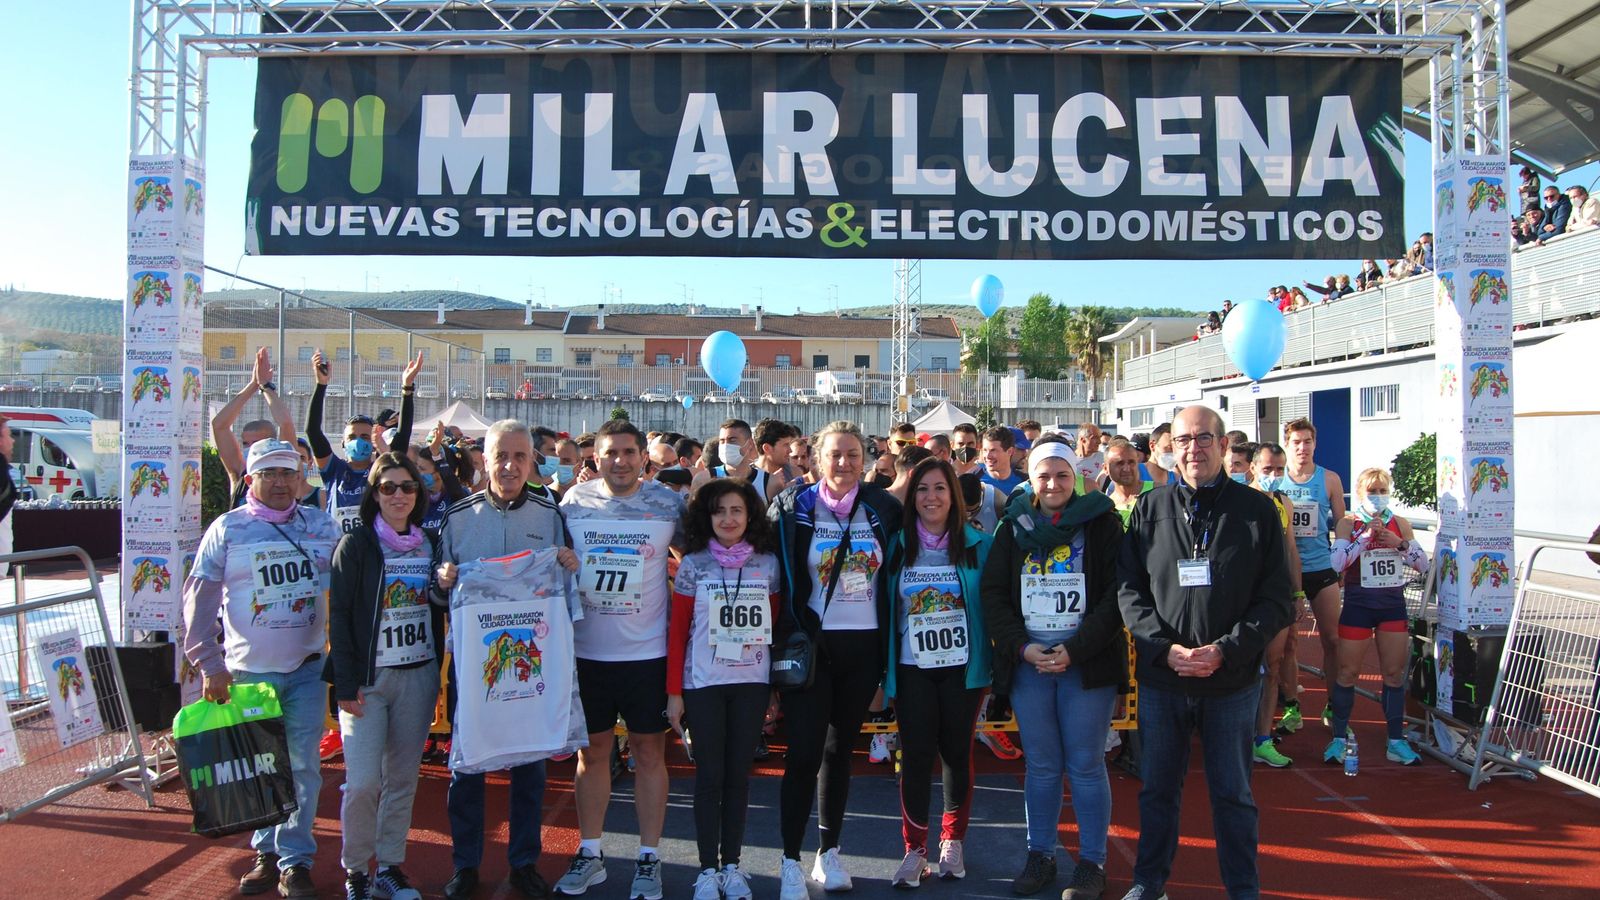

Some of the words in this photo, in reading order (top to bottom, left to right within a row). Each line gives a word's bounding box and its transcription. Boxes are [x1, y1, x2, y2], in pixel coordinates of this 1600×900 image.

[417, 90, 840, 196] MILAR
[892, 91, 1381, 198] LUCENA
[270, 205, 460, 238] NUEVAS
[476, 200, 813, 239] TECNOLOGÍAS
[819, 202, 869, 249] &
[870, 204, 1384, 242] ELECTRODOMÉSTICOS
[583, 531, 597, 539] VIII
[258, 560, 314, 587] 1004
[1369, 560, 1396, 576] 165
[595, 570, 628, 592] 777
[705, 583, 719, 591] VIII
[477, 613, 492, 623] VIII
[493, 614, 513, 622] MEDIA
[513, 611, 544, 619] MARATÓN
[480, 620, 506, 629] CIUDAD
[515, 617, 541, 625] LUCENA
[719, 605, 762, 628] 666
[382, 622, 428, 649] 1184
[914, 626, 967, 652] 1003
[214, 752, 278, 786] MILAR
